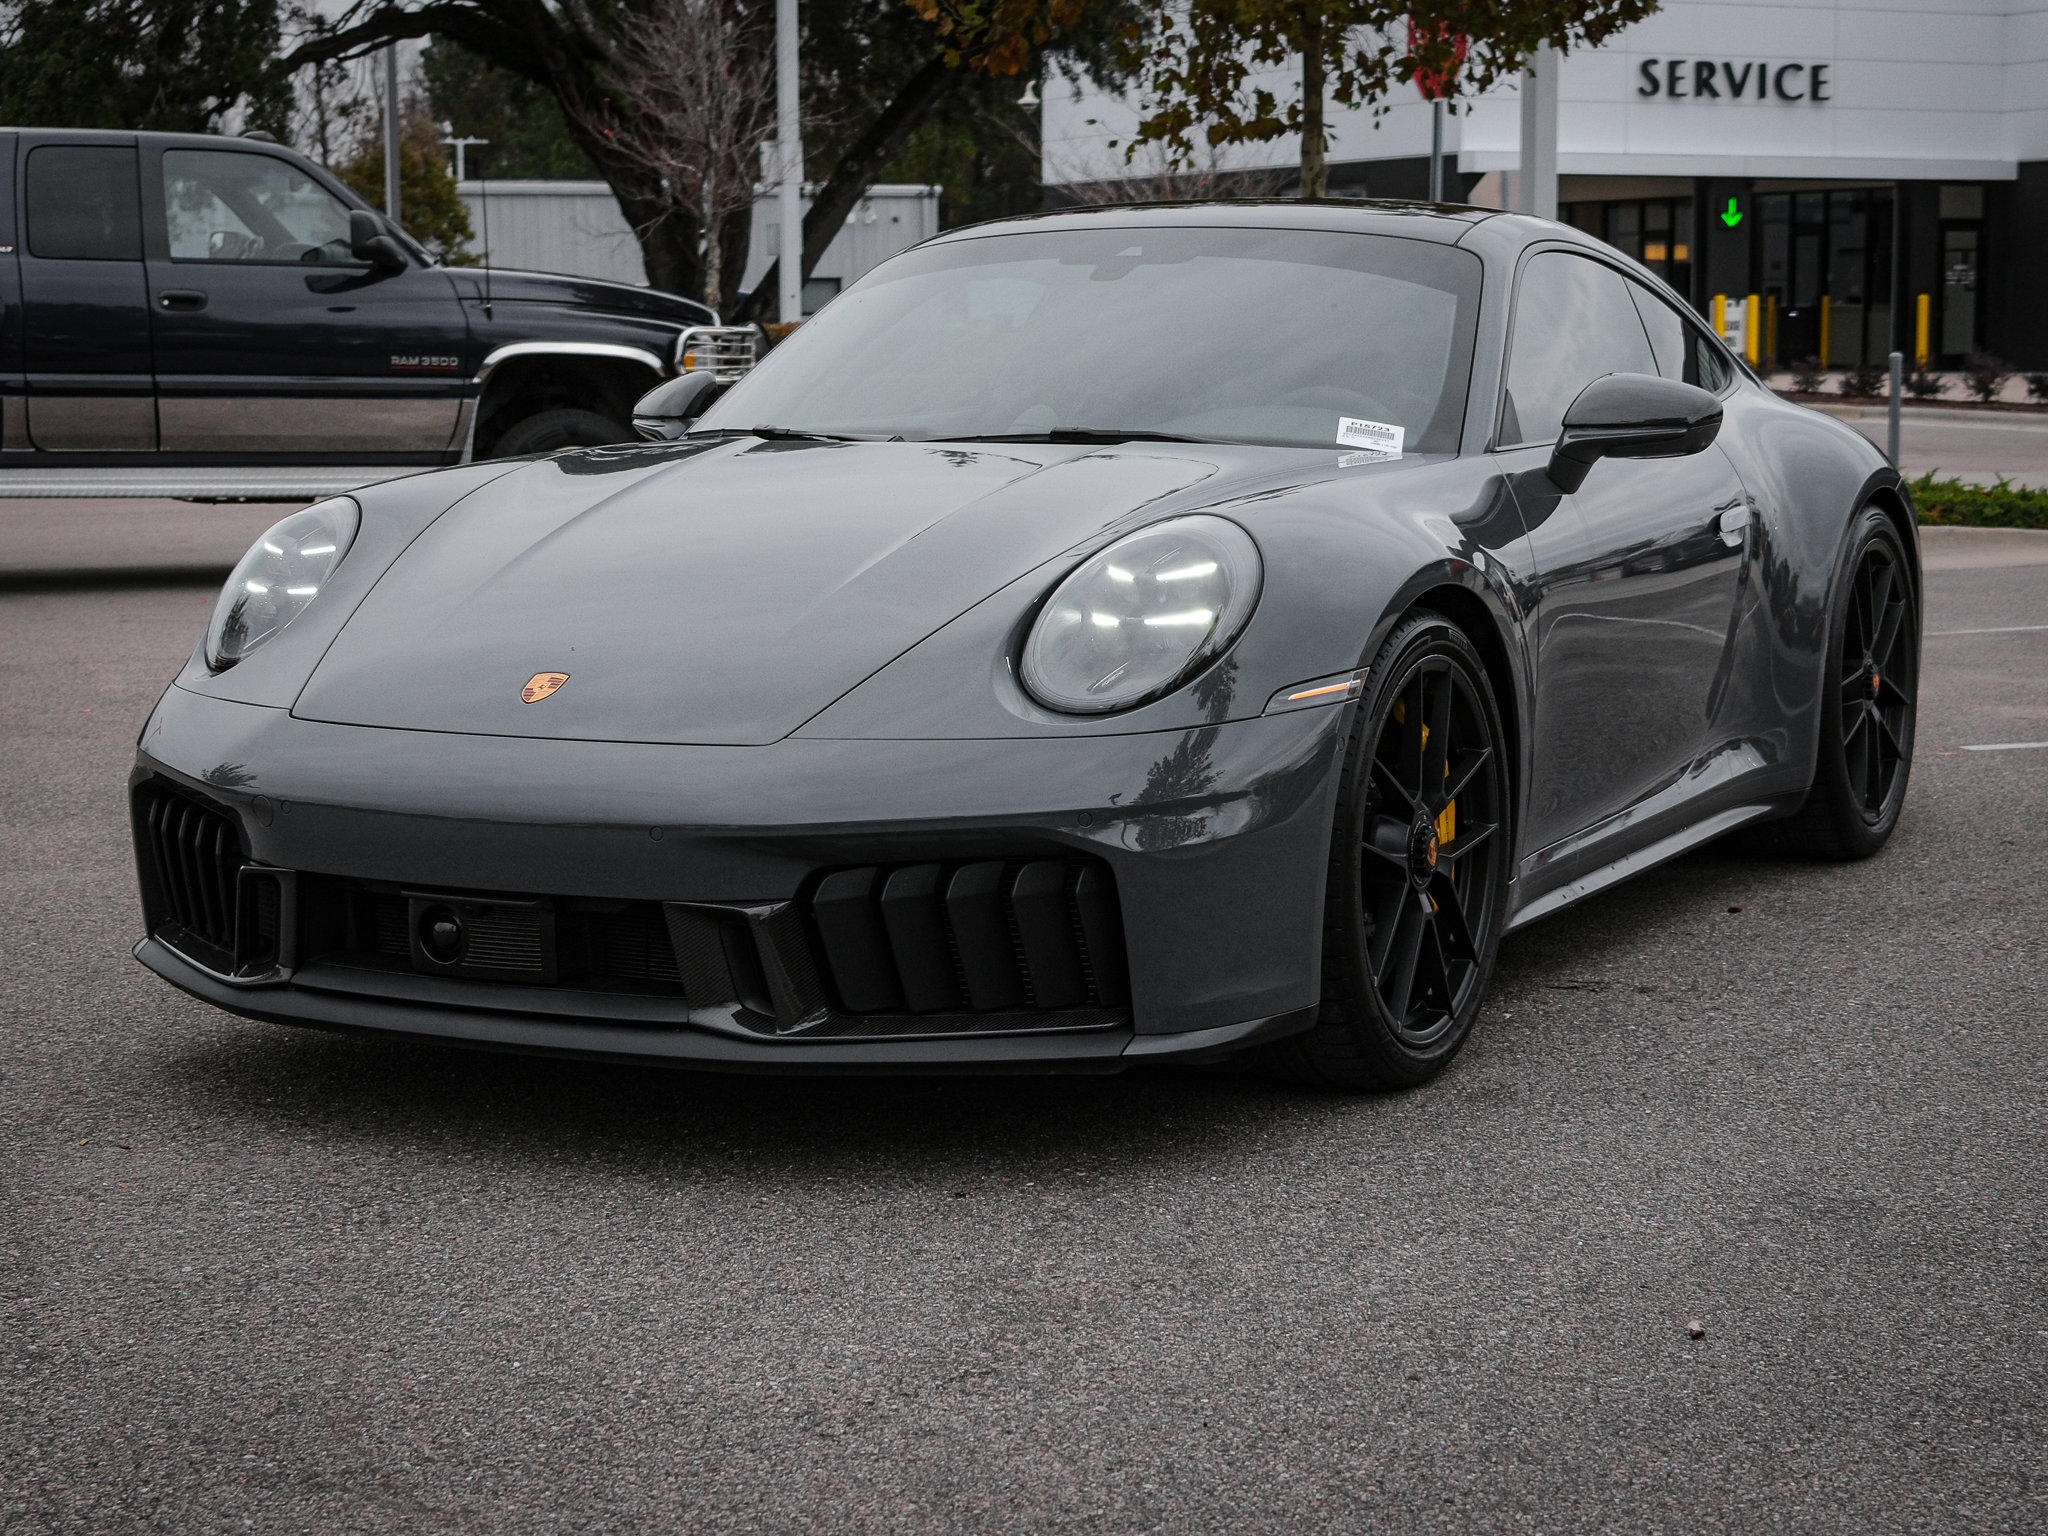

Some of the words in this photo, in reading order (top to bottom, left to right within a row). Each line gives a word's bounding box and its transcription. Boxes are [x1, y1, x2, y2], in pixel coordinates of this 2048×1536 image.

[1637, 58, 1832, 101] SERVICE
[391, 355, 420, 366] RAM
[421, 356, 459, 366] 3500
